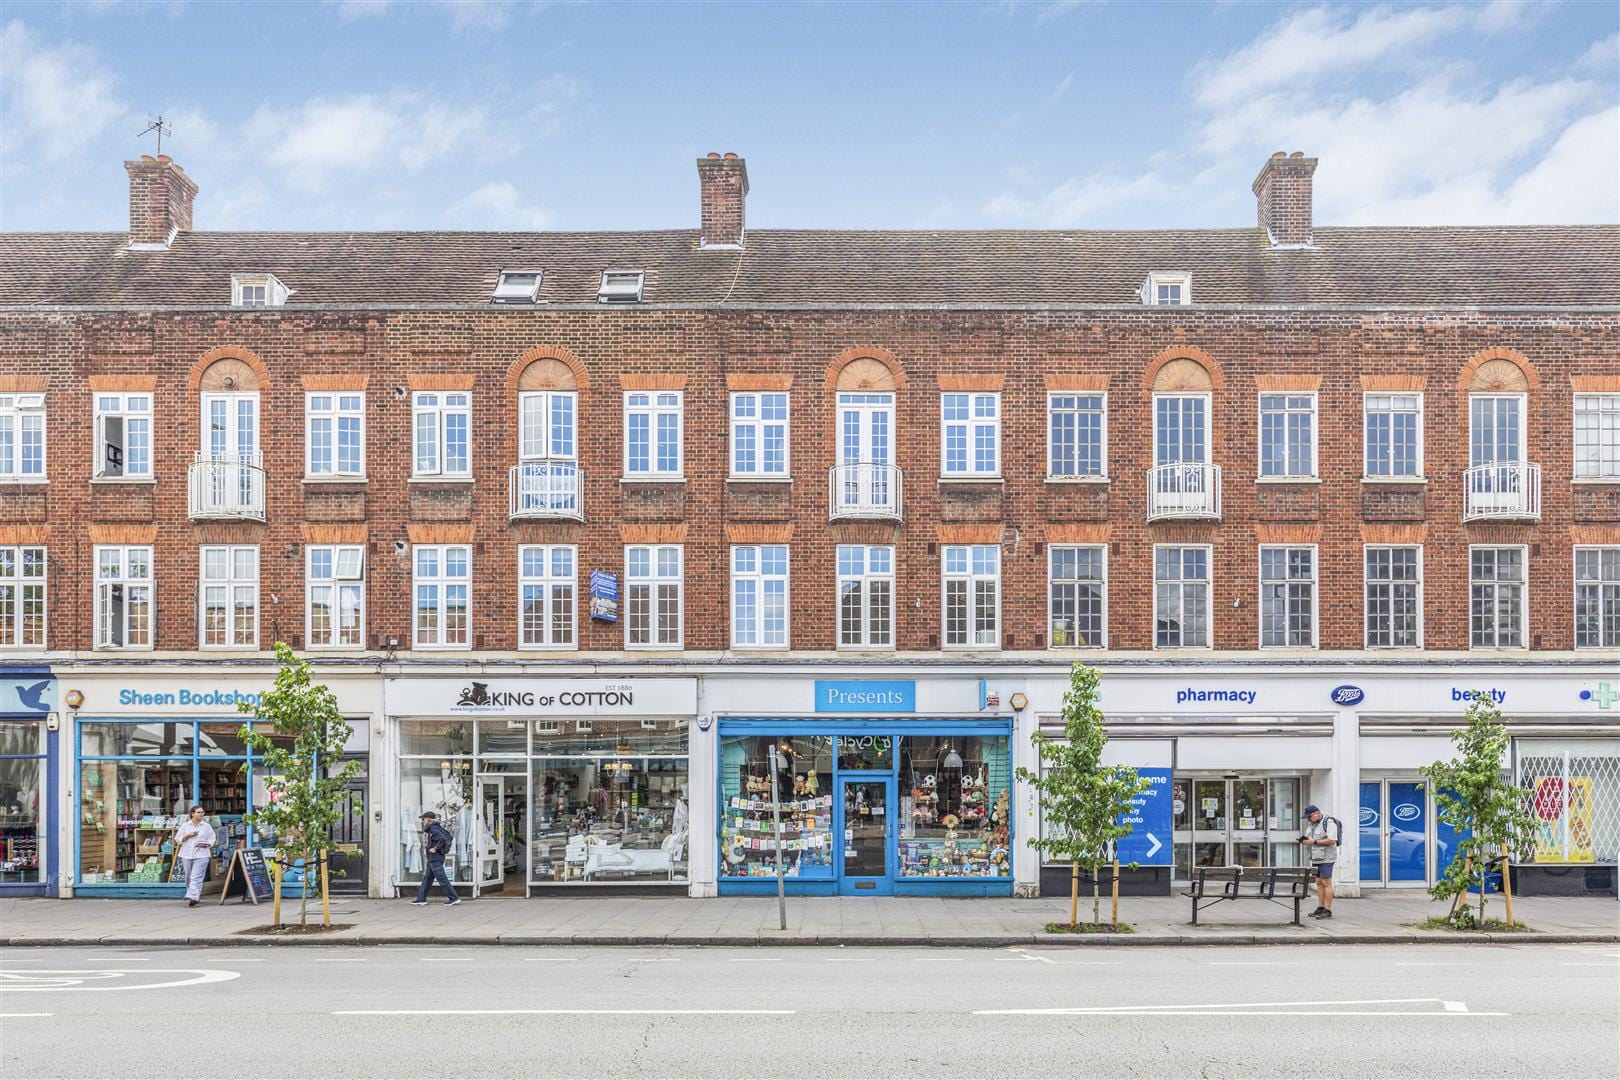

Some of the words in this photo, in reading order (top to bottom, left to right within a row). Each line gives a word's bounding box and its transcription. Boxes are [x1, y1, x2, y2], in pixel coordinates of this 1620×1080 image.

[119, 688, 175, 705] Sheen
[491, 692, 534, 706] KING
[559, 692, 633, 706] COTTON
[828, 688, 903, 704] Presents
[1176, 688, 1257, 704] pharmacy
[1452, 687, 1506, 704] beaty
[1122, 816, 1144, 824] photo
